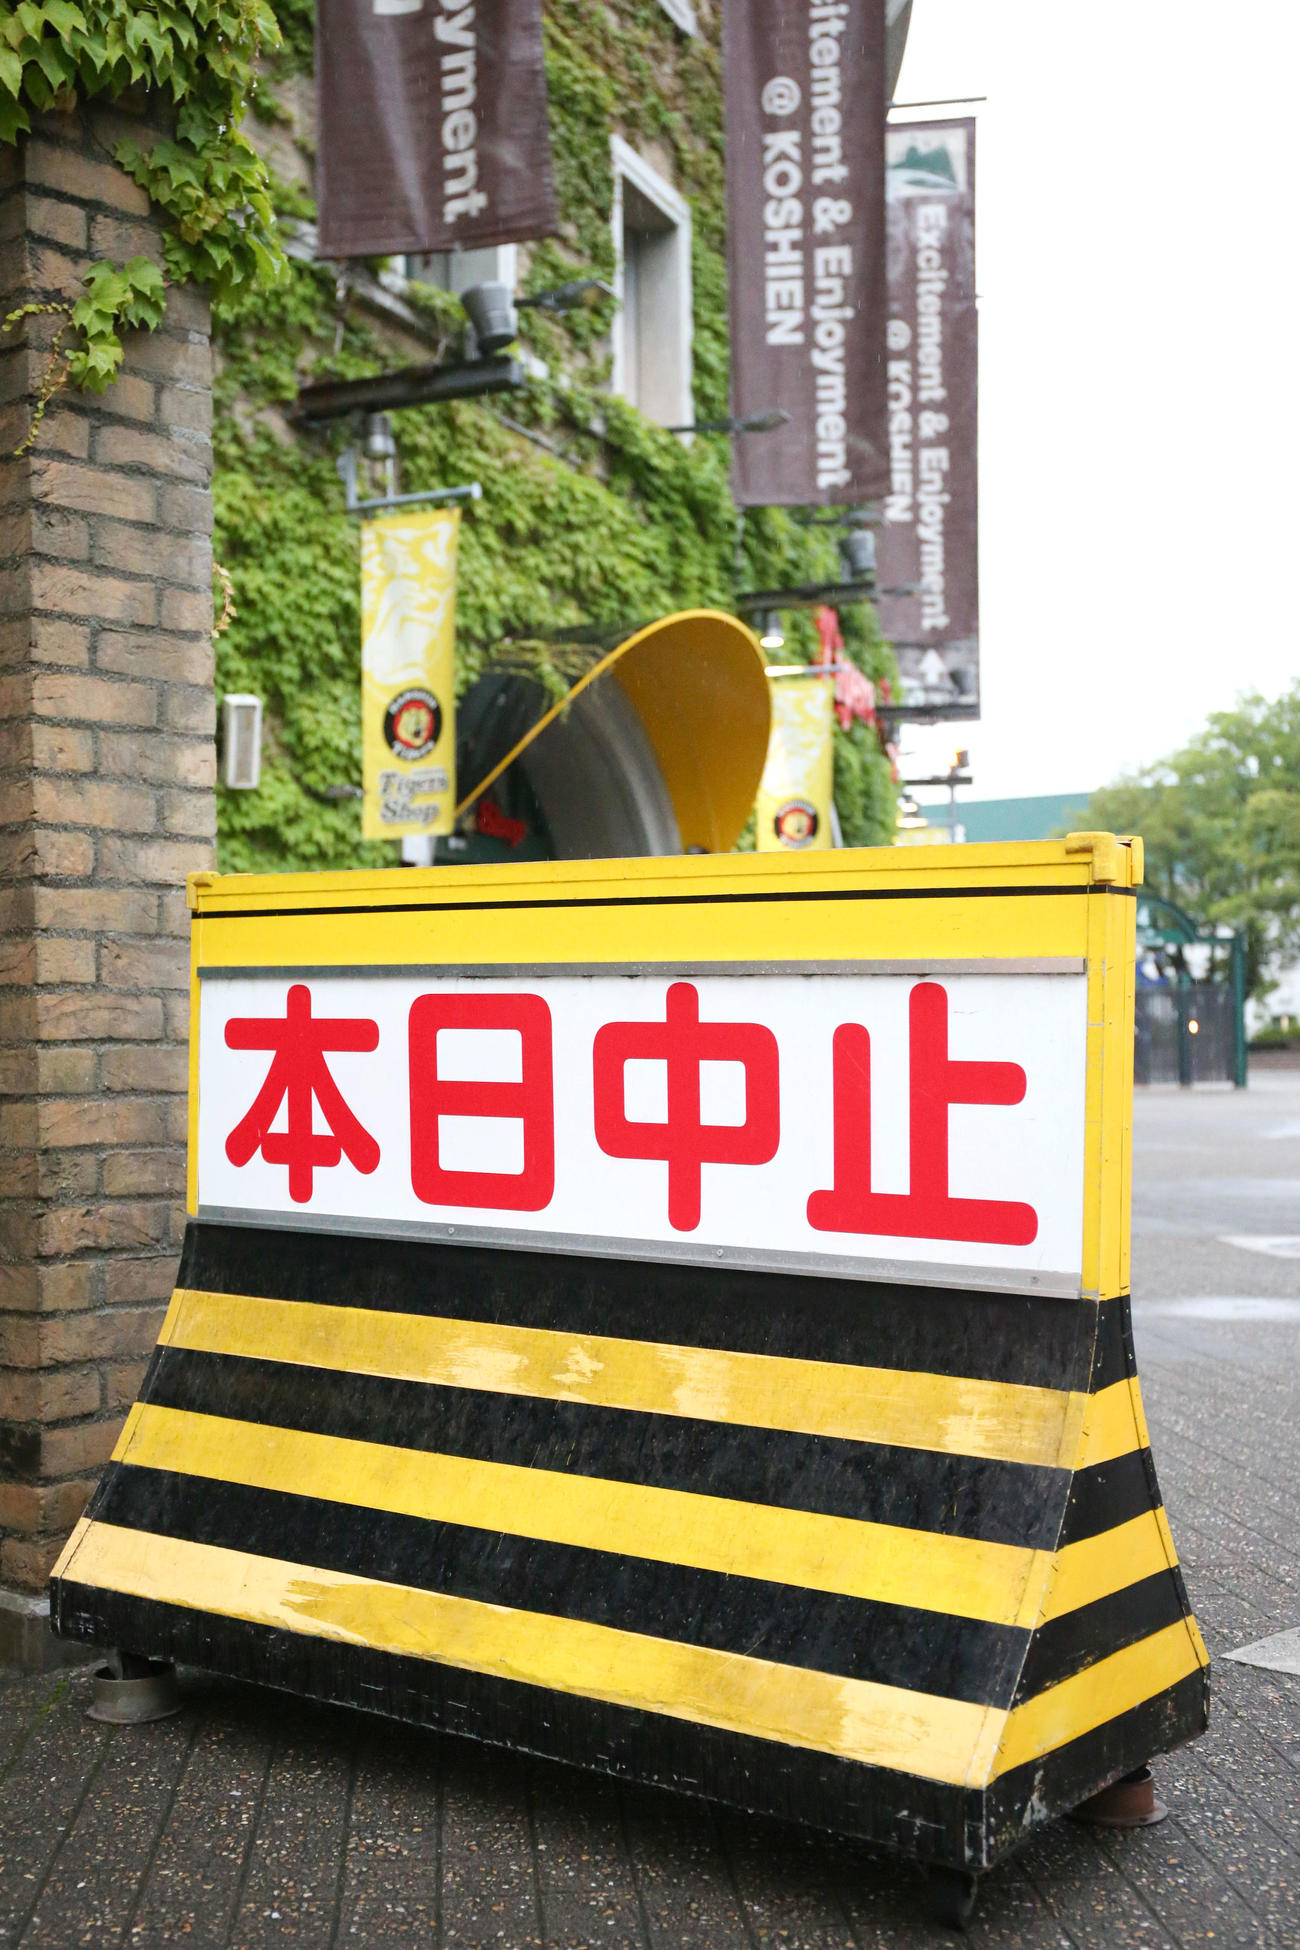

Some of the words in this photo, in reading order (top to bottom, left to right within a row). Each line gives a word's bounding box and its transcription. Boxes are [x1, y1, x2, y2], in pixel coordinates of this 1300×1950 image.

[761, 76, 802, 116] @
[808, 0, 850, 185] itement
[763, 130, 804, 345] KOSHIEN
[812, 197, 852, 234] &
[916, 203, 948, 402] Excitement
[810, 245, 855, 489] Enjoyment
[918, 410, 950, 439] &
[916, 446, 951, 631] Enjoyment
[380, 799, 440, 826] Shop
[224, 980, 1038, 1246] 本日中止
